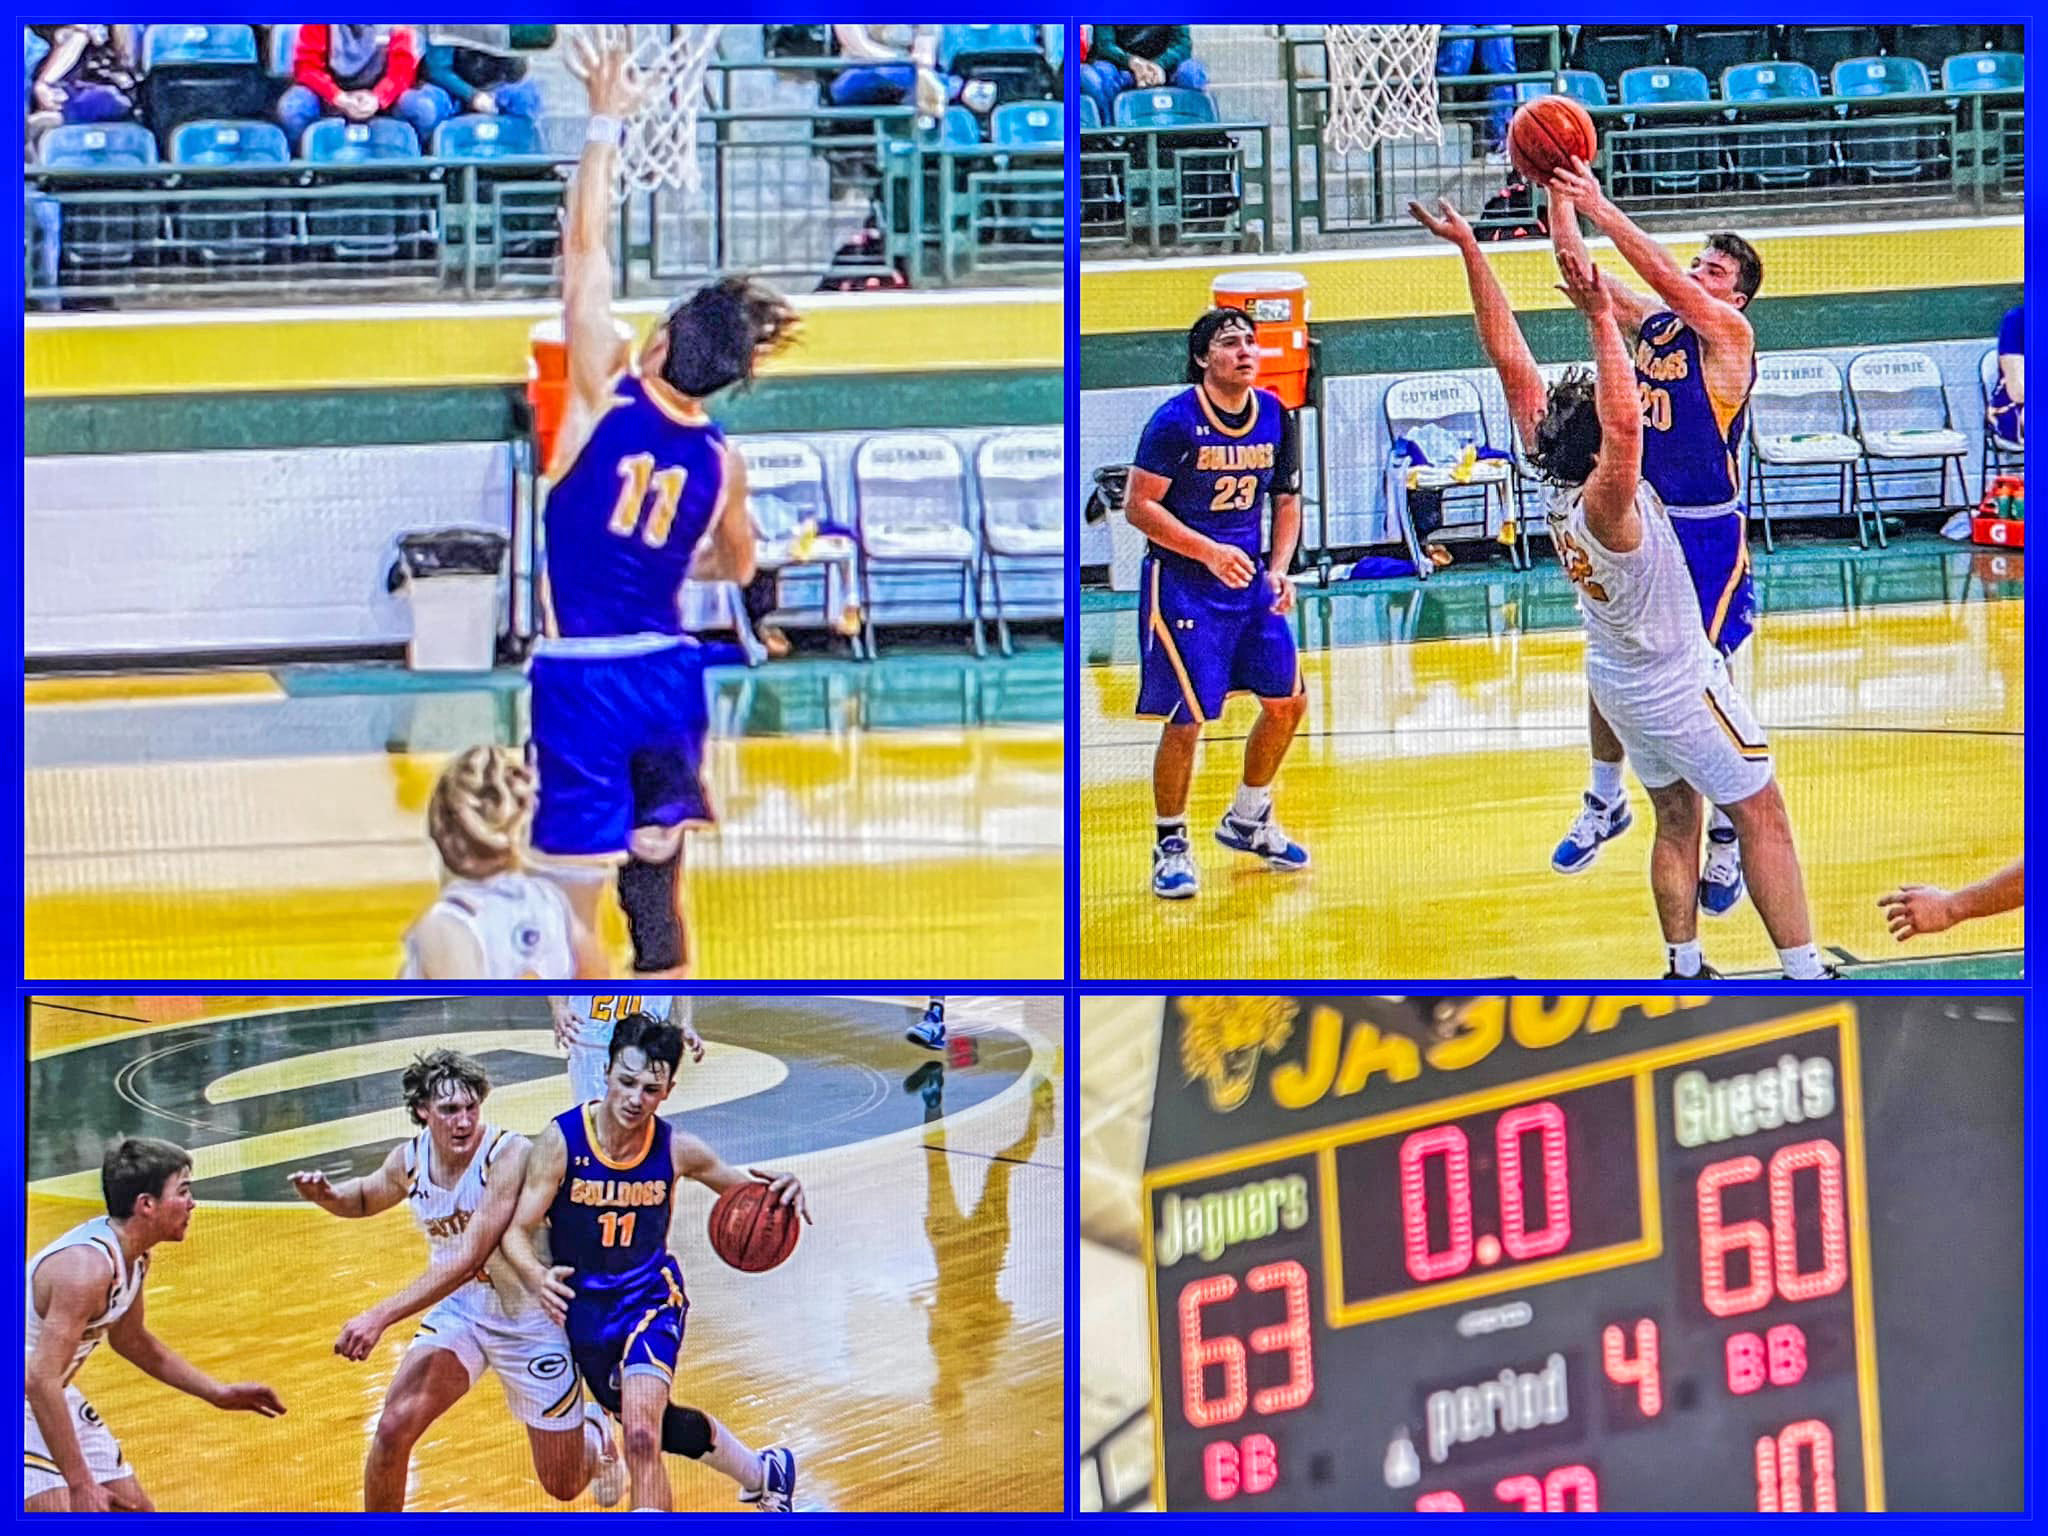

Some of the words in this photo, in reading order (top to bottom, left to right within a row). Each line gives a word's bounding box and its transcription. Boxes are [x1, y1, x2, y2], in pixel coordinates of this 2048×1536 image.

[1761, 367, 1824, 381] GUTHRIE
[1863, 361, 1926, 376] GUTHRIE
[1196, 443, 1274, 470] BULLDOGS
[607, 451, 689, 549] 11
[1209, 475, 1259, 512] 23
[1988, 524, 2007, 543] G
[1673, 1054, 1836, 1148] Guests
[570, 1177, 667, 1207] BULLDOGS
[1156, 1173, 1309, 1267] Jaguars
[1400, 1100, 1571, 1281] 0.0
[598, 1211, 637, 1248] 11
[1697, 1138, 1848, 1318] 60
[1178, 1260, 1315, 1428] 63
[1603, 1317, 1662, 1417] 4
[1725, 1323, 1808, 1395] BB
[1427, 1352, 1569, 1464] period
[1203, 1433, 1279, 1500] BB
